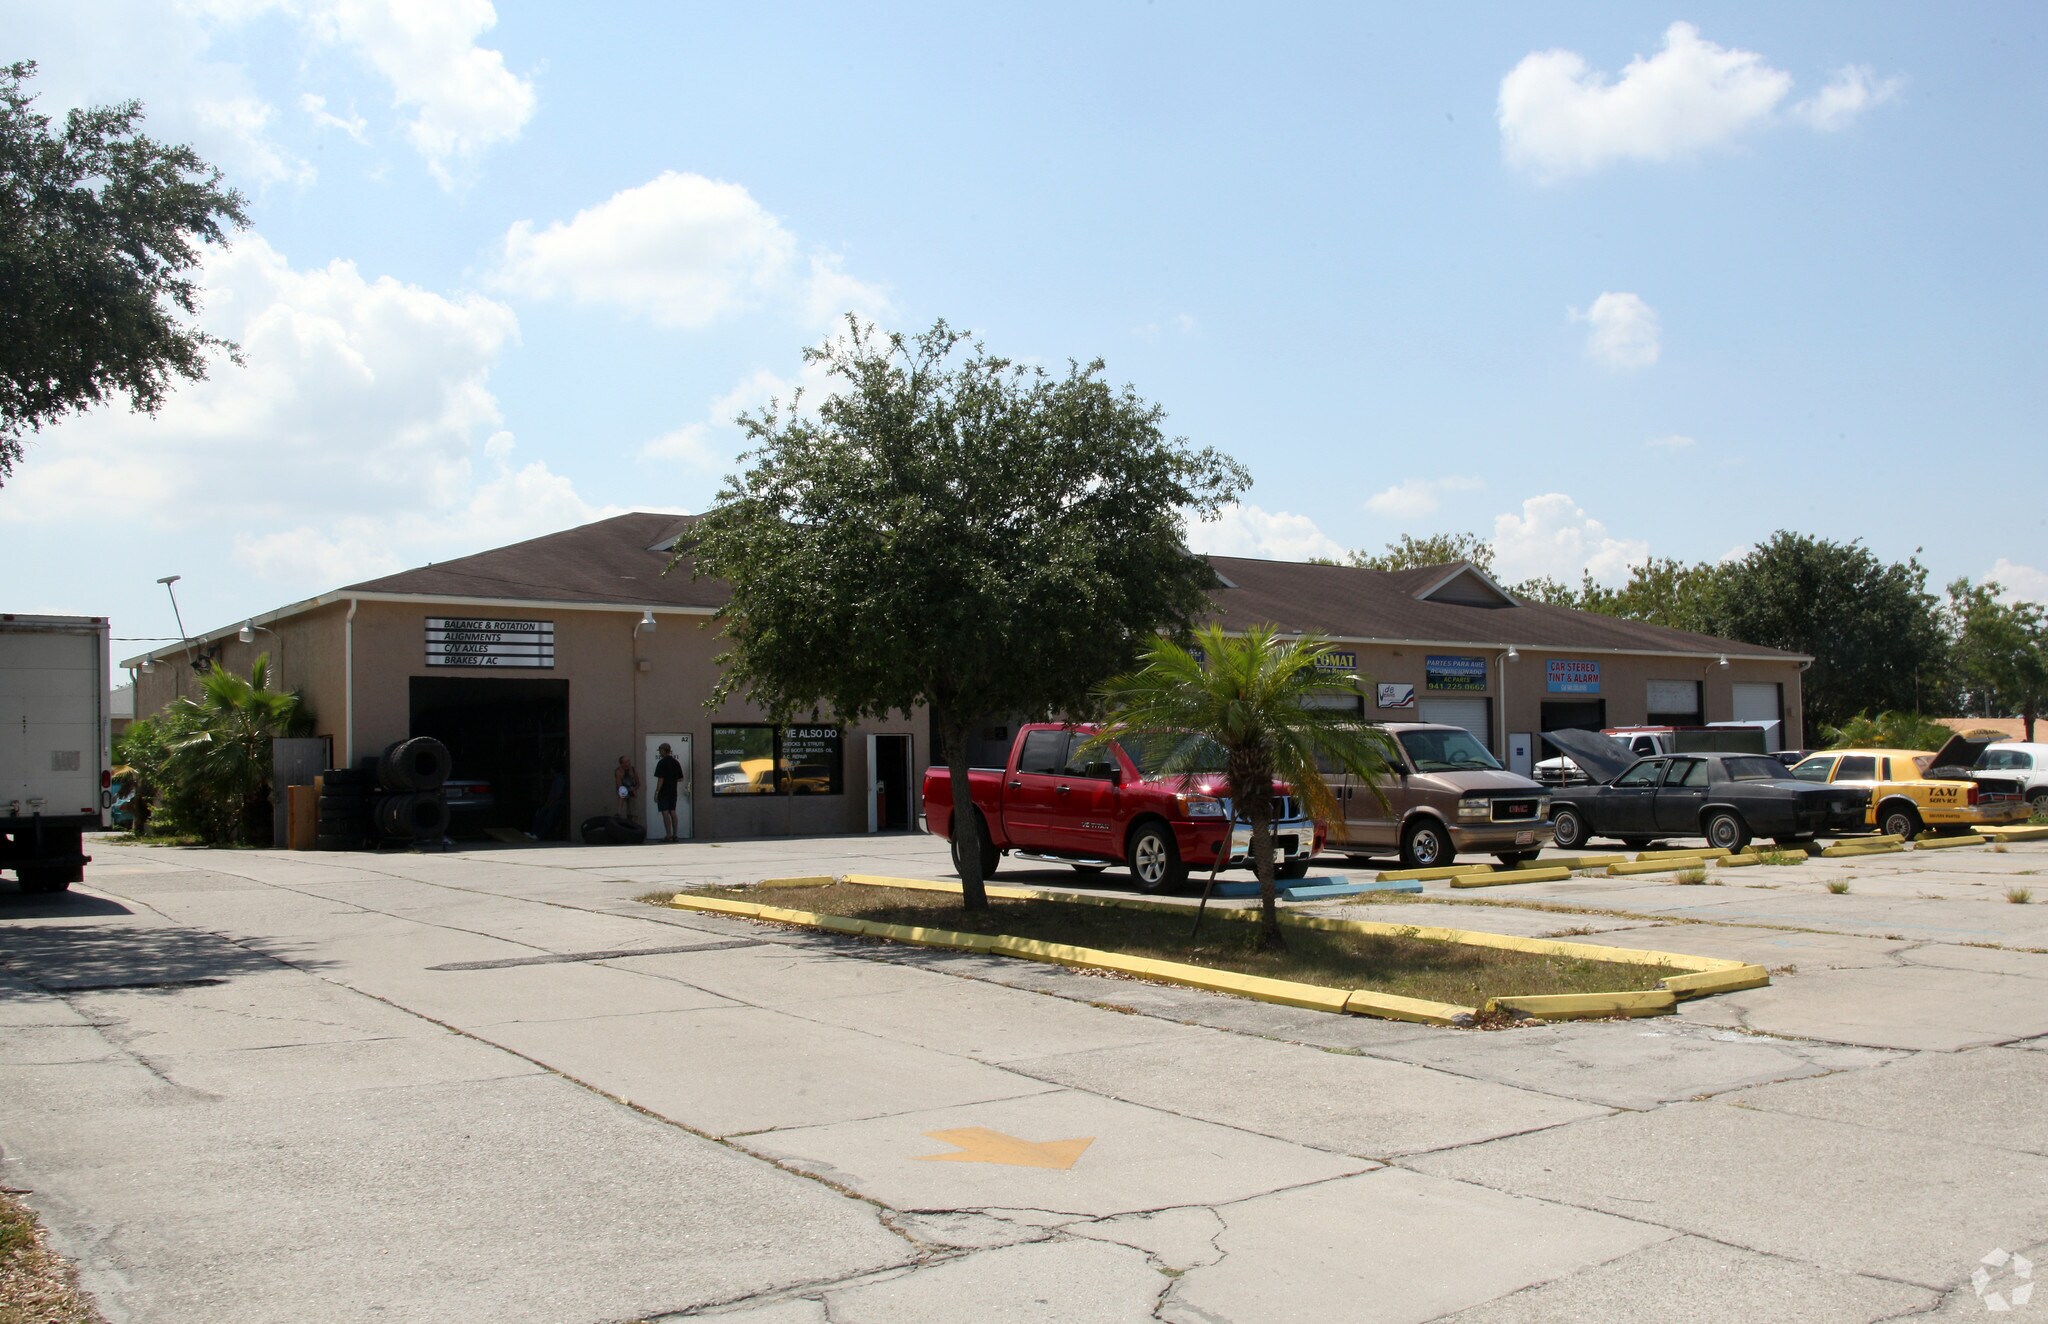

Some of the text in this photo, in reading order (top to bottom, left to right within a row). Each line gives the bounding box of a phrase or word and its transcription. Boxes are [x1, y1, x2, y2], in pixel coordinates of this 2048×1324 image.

[444, 620, 536, 631] BALANCE & ROTATION
[444, 632, 502, 642] ALIGNMENTS
[444, 643, 489, 653] C/V AXLES
[444, 656, 478, 665] BRAKES
[486, 657, 499, 665] AC
[1551, 662, 1595, 672] CAR STEREO
[1548, 672, 1599, 683] TINT & ALARM
[798, 729, 823, 738] ALSO
[824, 729, 837, 738] DO
[1929, 787, 1958, 796] TAXI
[1509, 804, 1528, 813] GMC
[1091, 822, 1110, 830] TITAN
